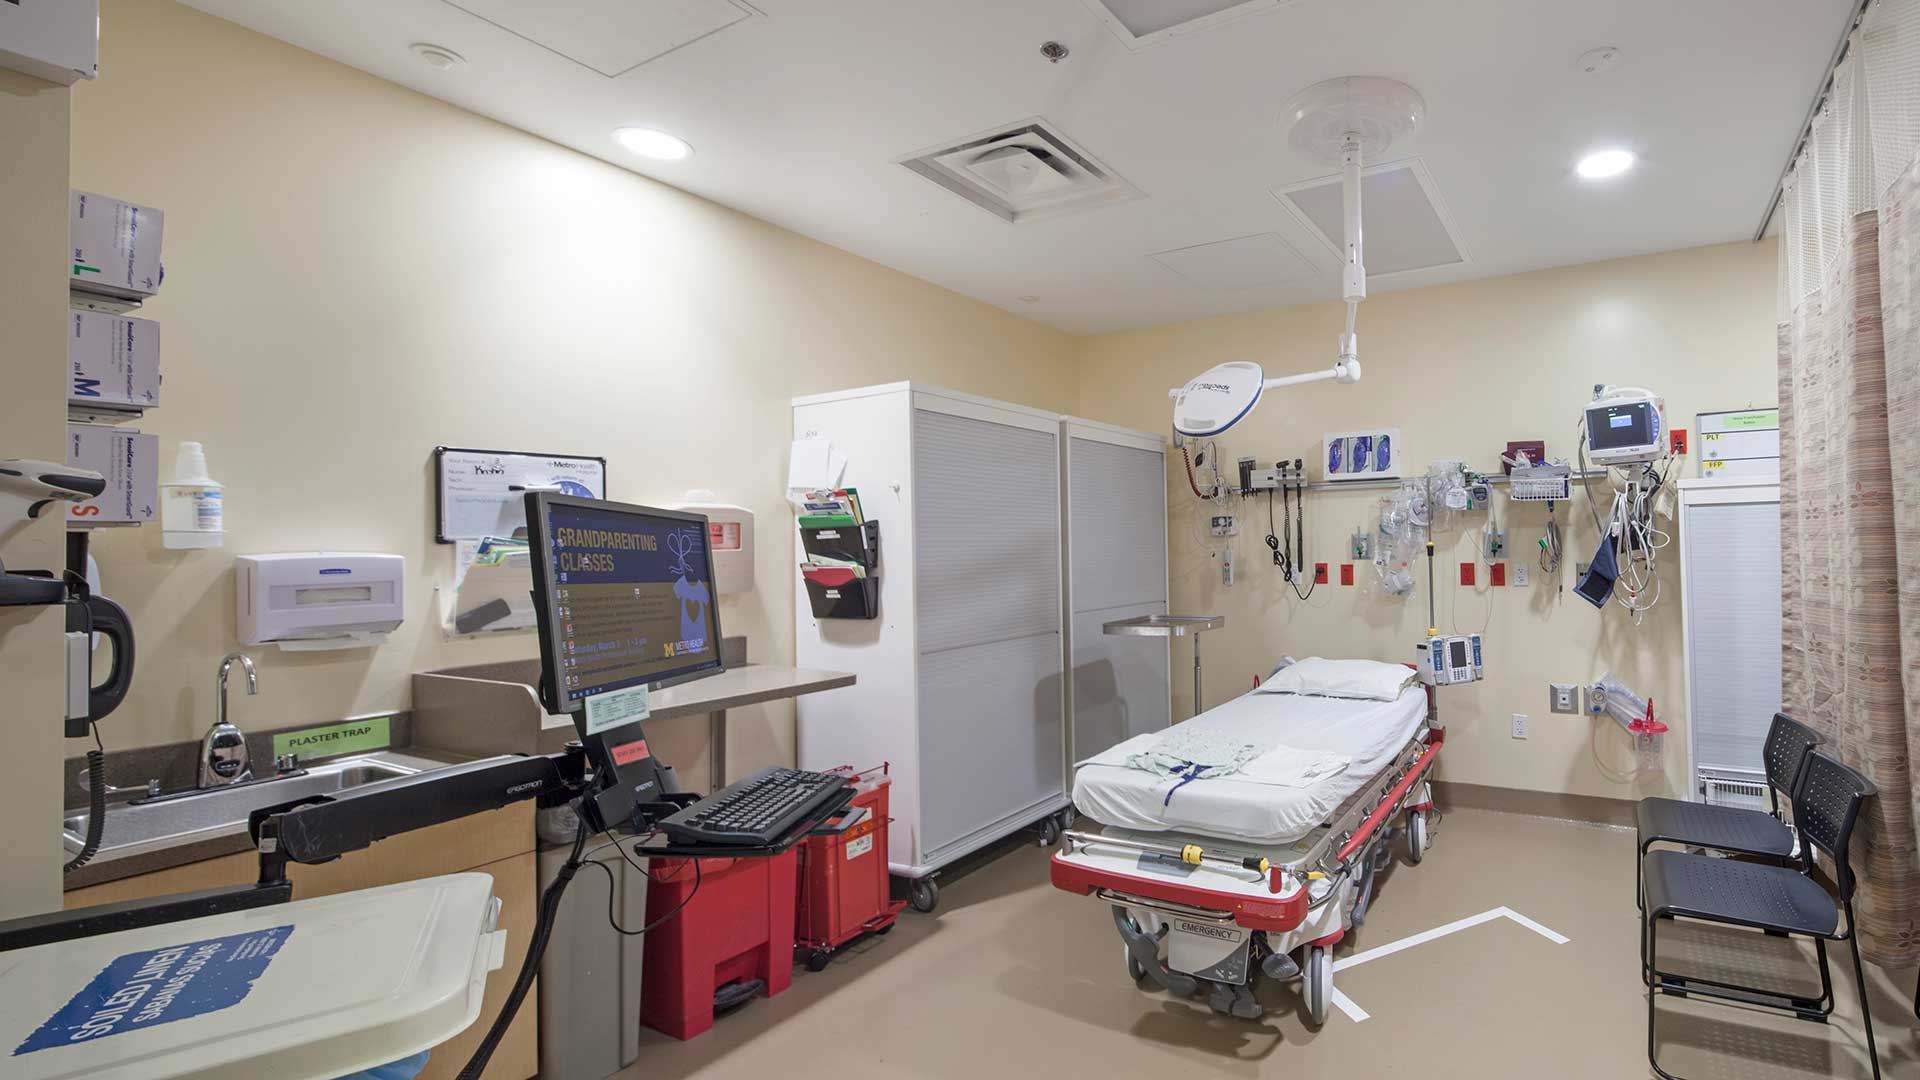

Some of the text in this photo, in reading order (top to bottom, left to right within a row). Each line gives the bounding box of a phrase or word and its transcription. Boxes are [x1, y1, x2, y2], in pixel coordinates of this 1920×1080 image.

[74, 264, 101, 275] L
[74, 378, 101, 397] M
[71, 505, 99, 517] S
[557, 527, 657, 551] GRANDPARENTING
[560, 552, 615, 572] CLASSES
[289, 727, 372, 747] PLASTER TRAP
[1181, 922, 1233, 939] EMERGENCY
[132, 973, 195, 1023] SABANAS
[70, 982, 152, 1041] SOILED
